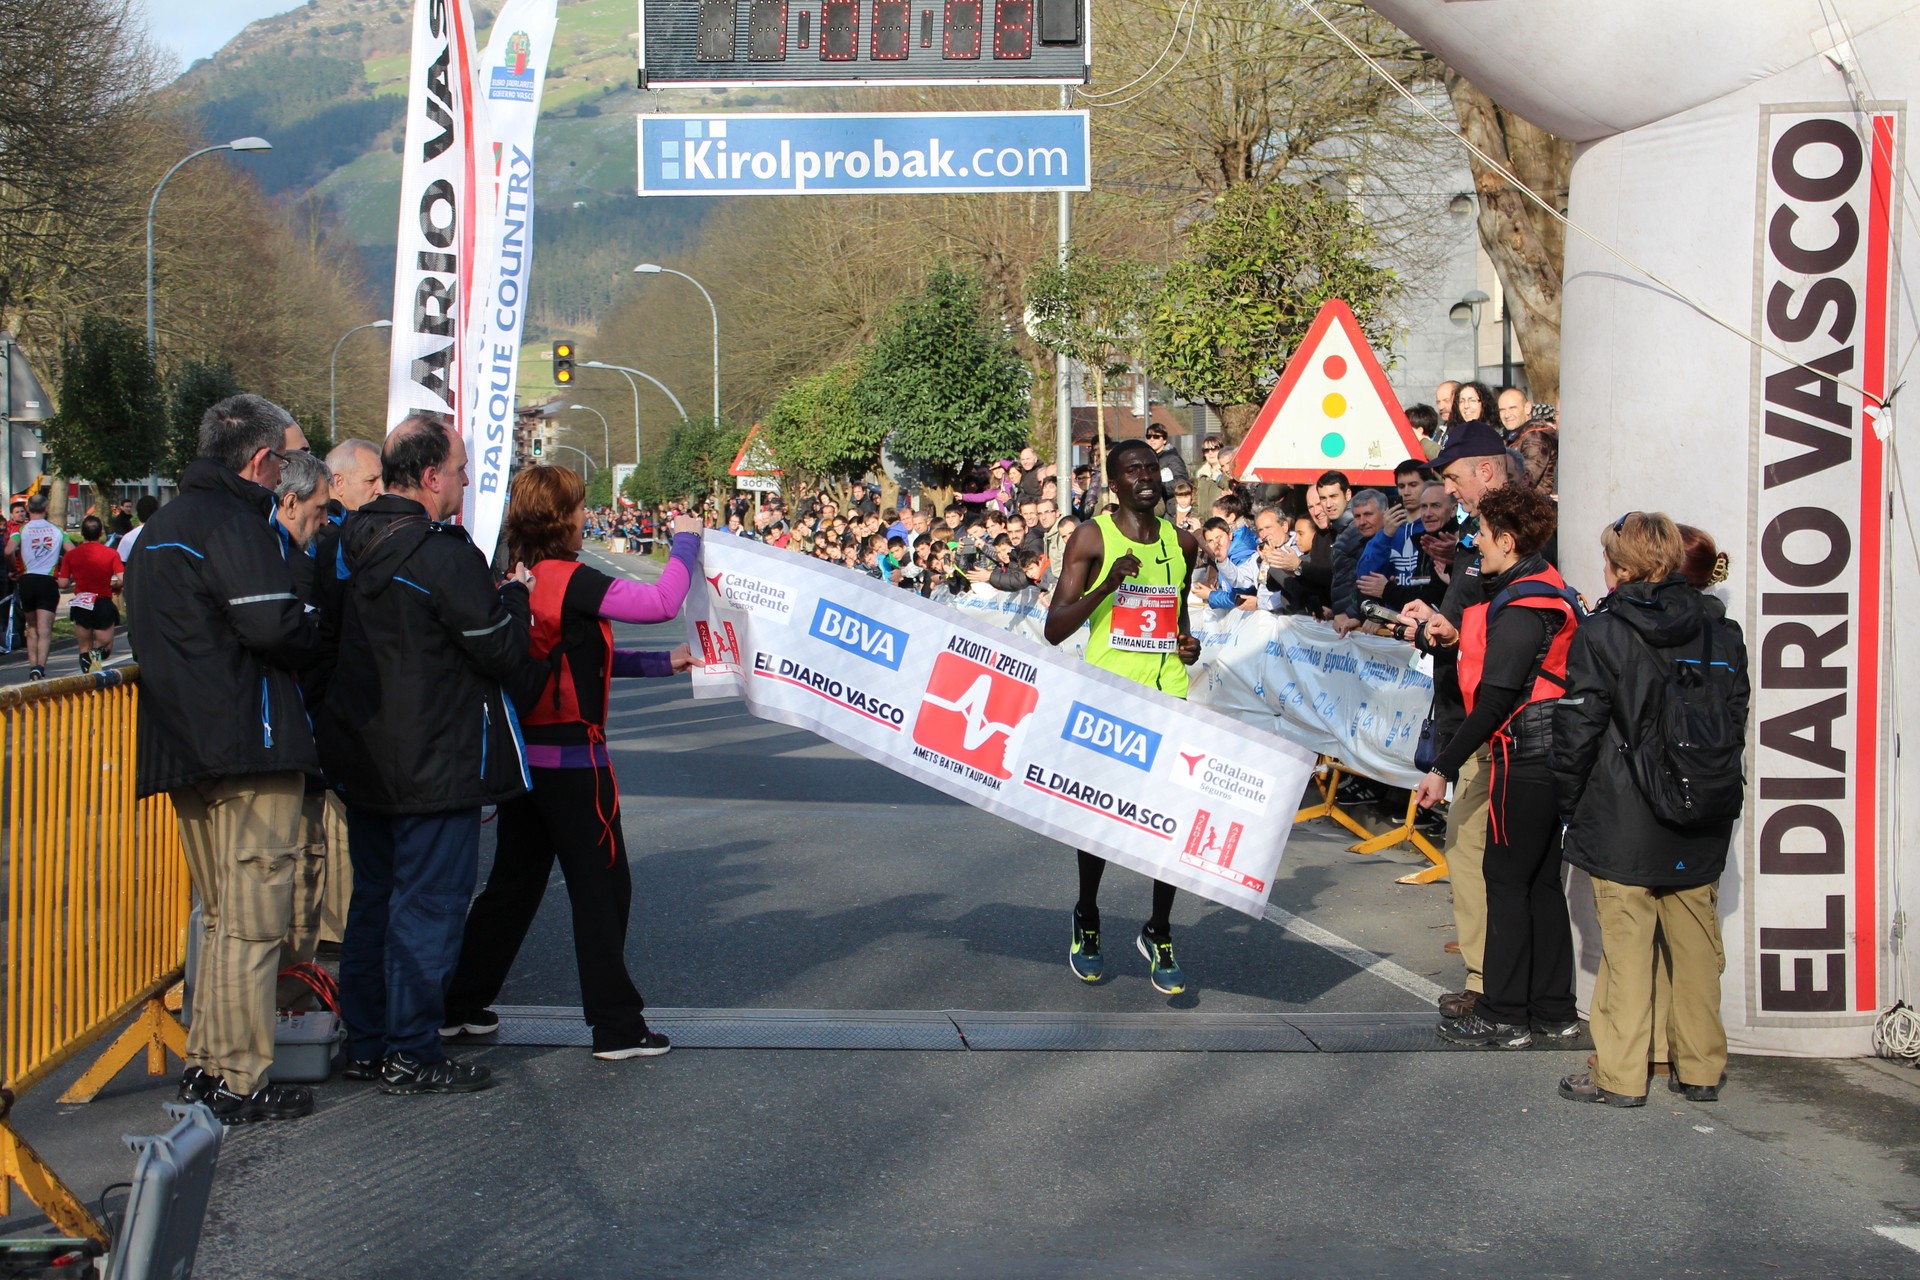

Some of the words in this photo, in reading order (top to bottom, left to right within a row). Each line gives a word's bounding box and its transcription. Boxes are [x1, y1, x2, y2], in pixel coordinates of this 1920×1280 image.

[684, 138, 1068, 190] Kirolprobak.com
[496, 144, 532, 332] COUNTRY
[1763, 118, 1863, 490] VASCO
[480, 343, 513, 495] BASQUE
[725, 573, 786, 600] Catalana
[725, 587, 790, 614] Occidente
[728, 600, 754, 611] Seguros
[1129, 585, 1157, 594] DIARIO
[818, 607, 896, 662] BBVA
[1139, 609, 1157, 632] 3
[699, 624, 714, 664] AZKOITI
[1112, 636, 1156, 649] EMMANUEL
[1157, 640, 1175, 650] BETT
[1323, 648, 1358, 673] gipuzkoa
[754, 651, 776, 672] EL
[778, 658, 843, 698] DIARIO
[846, 686, 905, 725] VASCO
[1759, 506, 1852, 876] DIARIO
[1071, 709, 1148, 764] BBVA
[912, 745, 938, 764] AMETS
[939, 756, 964, 775] BATEN
[964, 766, 1003, 791] TAUPADAK
[1203, 770, 1267, 804] Occidente
[1207, 757, 1265, 789] Catalana
[1025, 763, 1047, 786] EL
[1049, 770, 1114, 810] DIARIO
[1117, 799, 1178, 835] VASCO
[1199, 783, 1232, 801] Seguros
[1188, 814, 1206, 855] AZKOITI
[1222, 826, 1240, 866] AZPEITI
[1760, 894, 1847, 1012] EL
